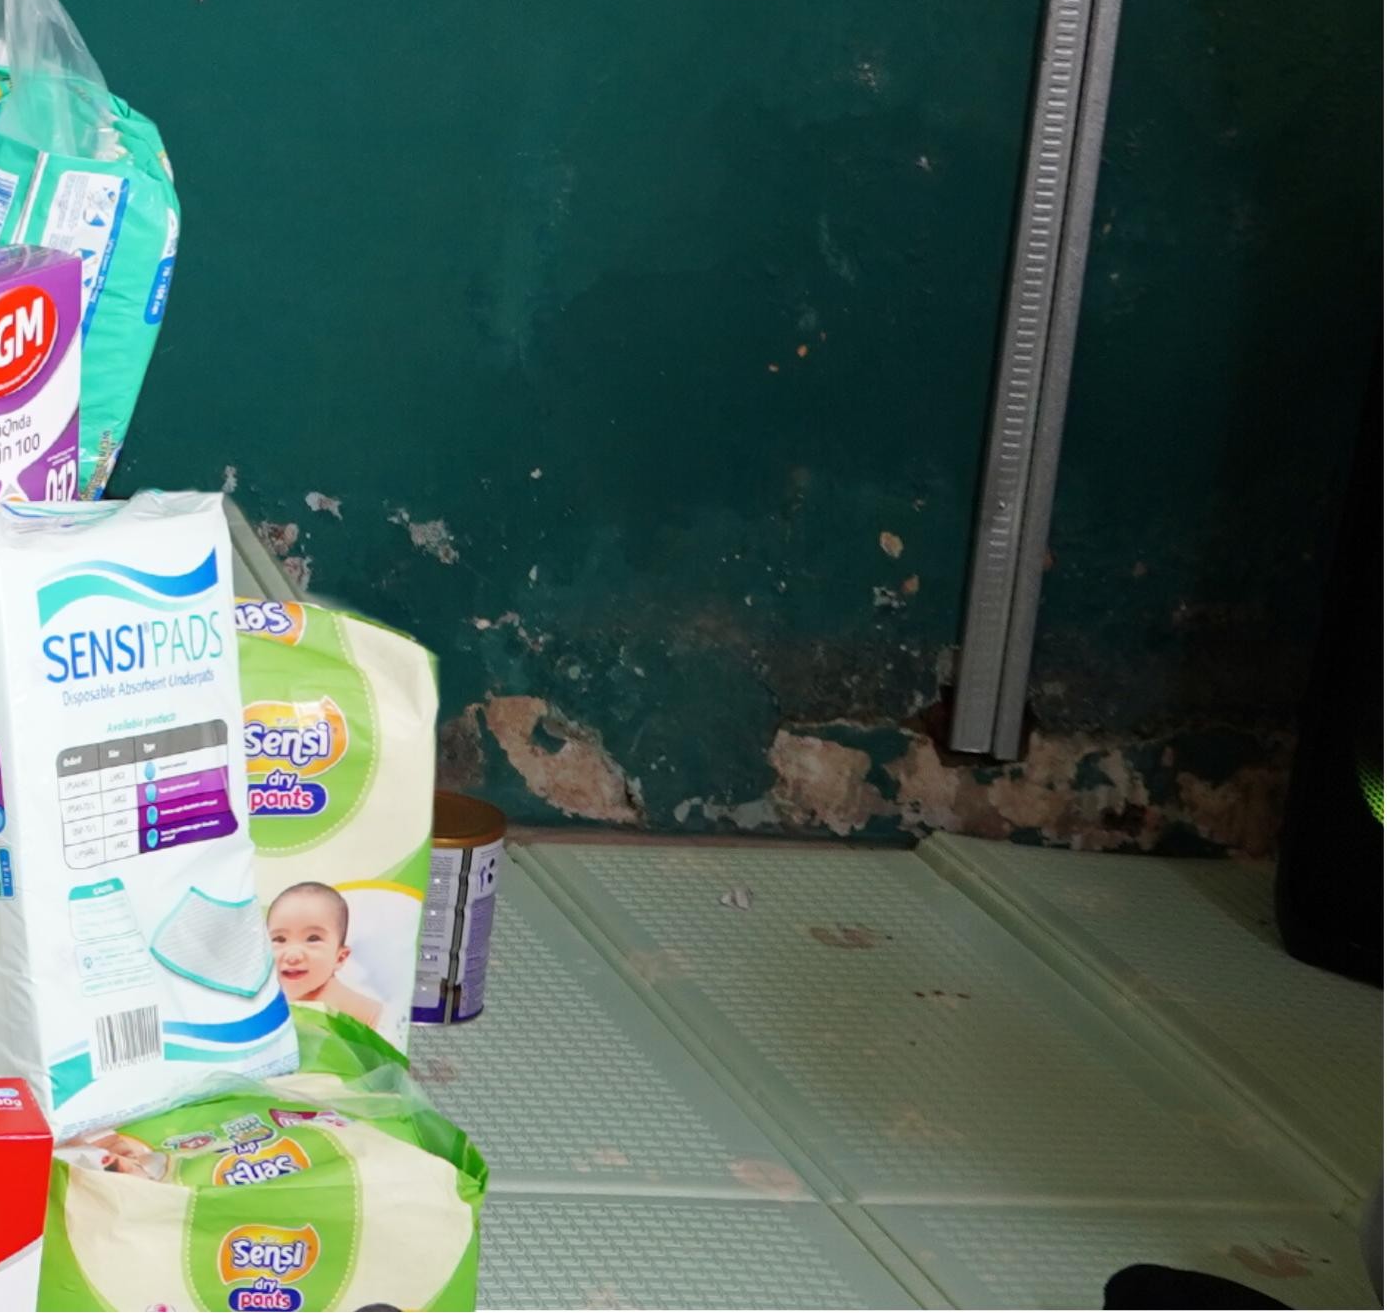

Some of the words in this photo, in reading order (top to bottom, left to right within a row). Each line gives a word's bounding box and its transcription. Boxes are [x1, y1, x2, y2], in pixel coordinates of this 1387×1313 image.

[15, 432, 41, 458] 100
[62, 685, 116, 708] Disposable
[117, 677, 167, 696] Absorbent
[243, 721, 331, 766] Sensi
[266, 769, 299, 788] dry
[249, 787, 315, 815] pants
[230, 1237, 305, 1275] Sensi
[252, 1276, 280, 1294] dry
[237, 1289, 292, 1310] pants
